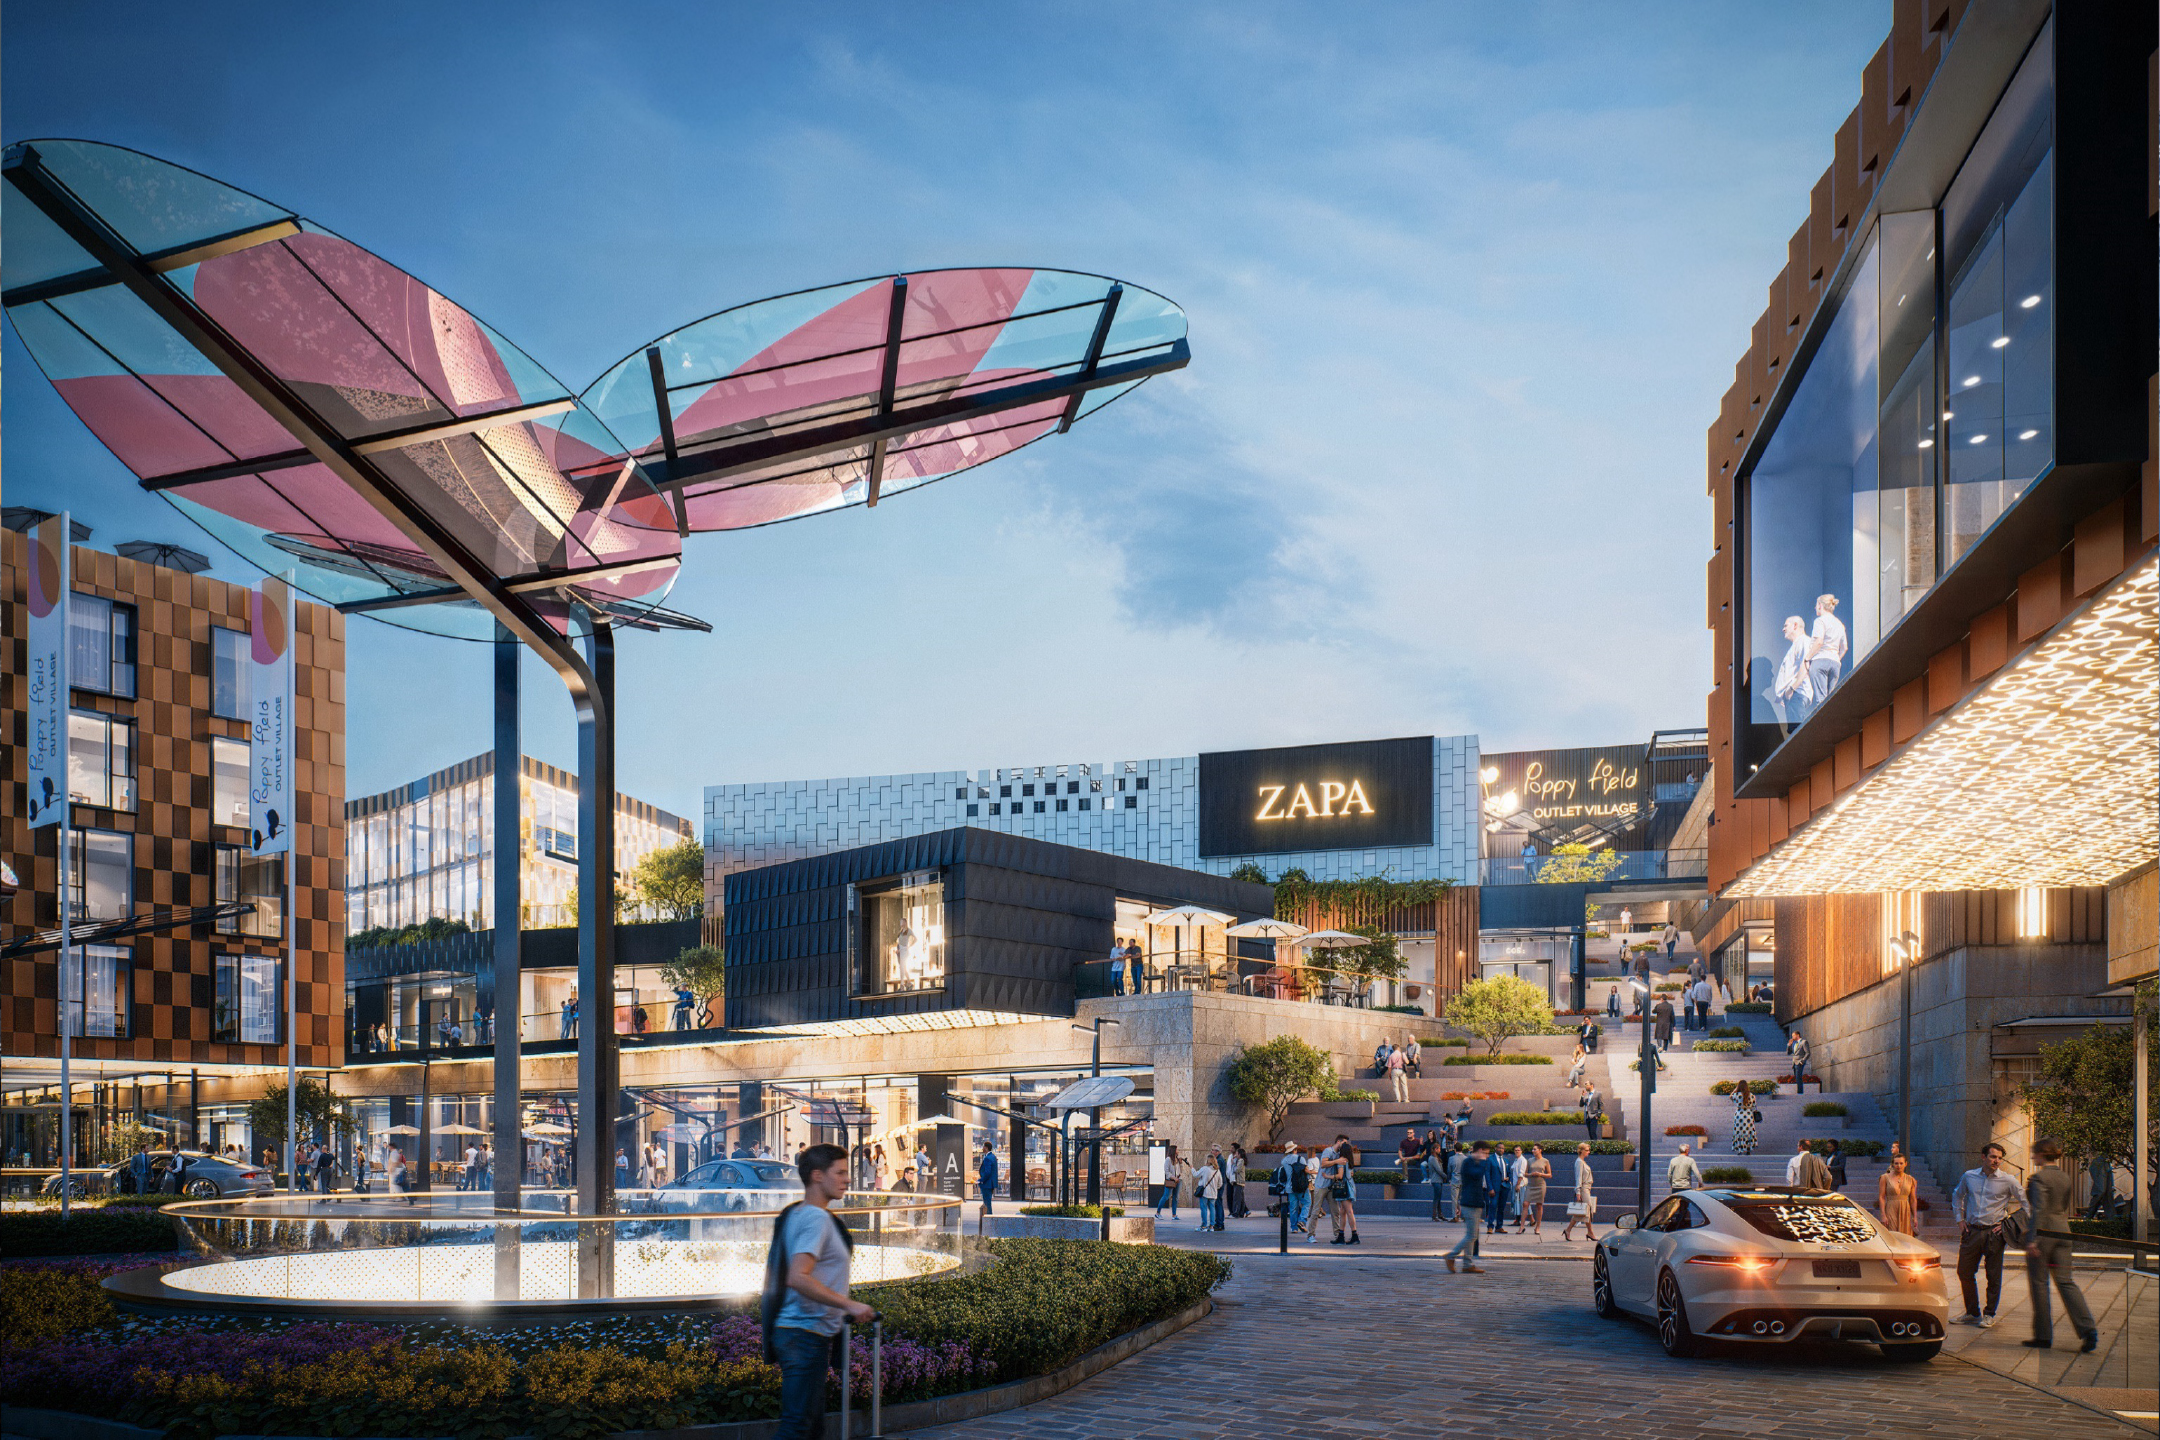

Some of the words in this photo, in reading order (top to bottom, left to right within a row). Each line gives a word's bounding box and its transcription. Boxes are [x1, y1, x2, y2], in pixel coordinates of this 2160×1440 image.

[29, 718, 47, 771] Poppy
[252, 756, 272, 804] Poppy
[1255, 779, 1376, 821] ZAPA
[1524, 761, 1577, 801] Poppy
[1588, 758, 1638, 796] field
[1533, 805, 1583, 818] OUTLET
[1584, 802, 1639, 817] VILLAGE
[945, 1152, 959, 1173] A
